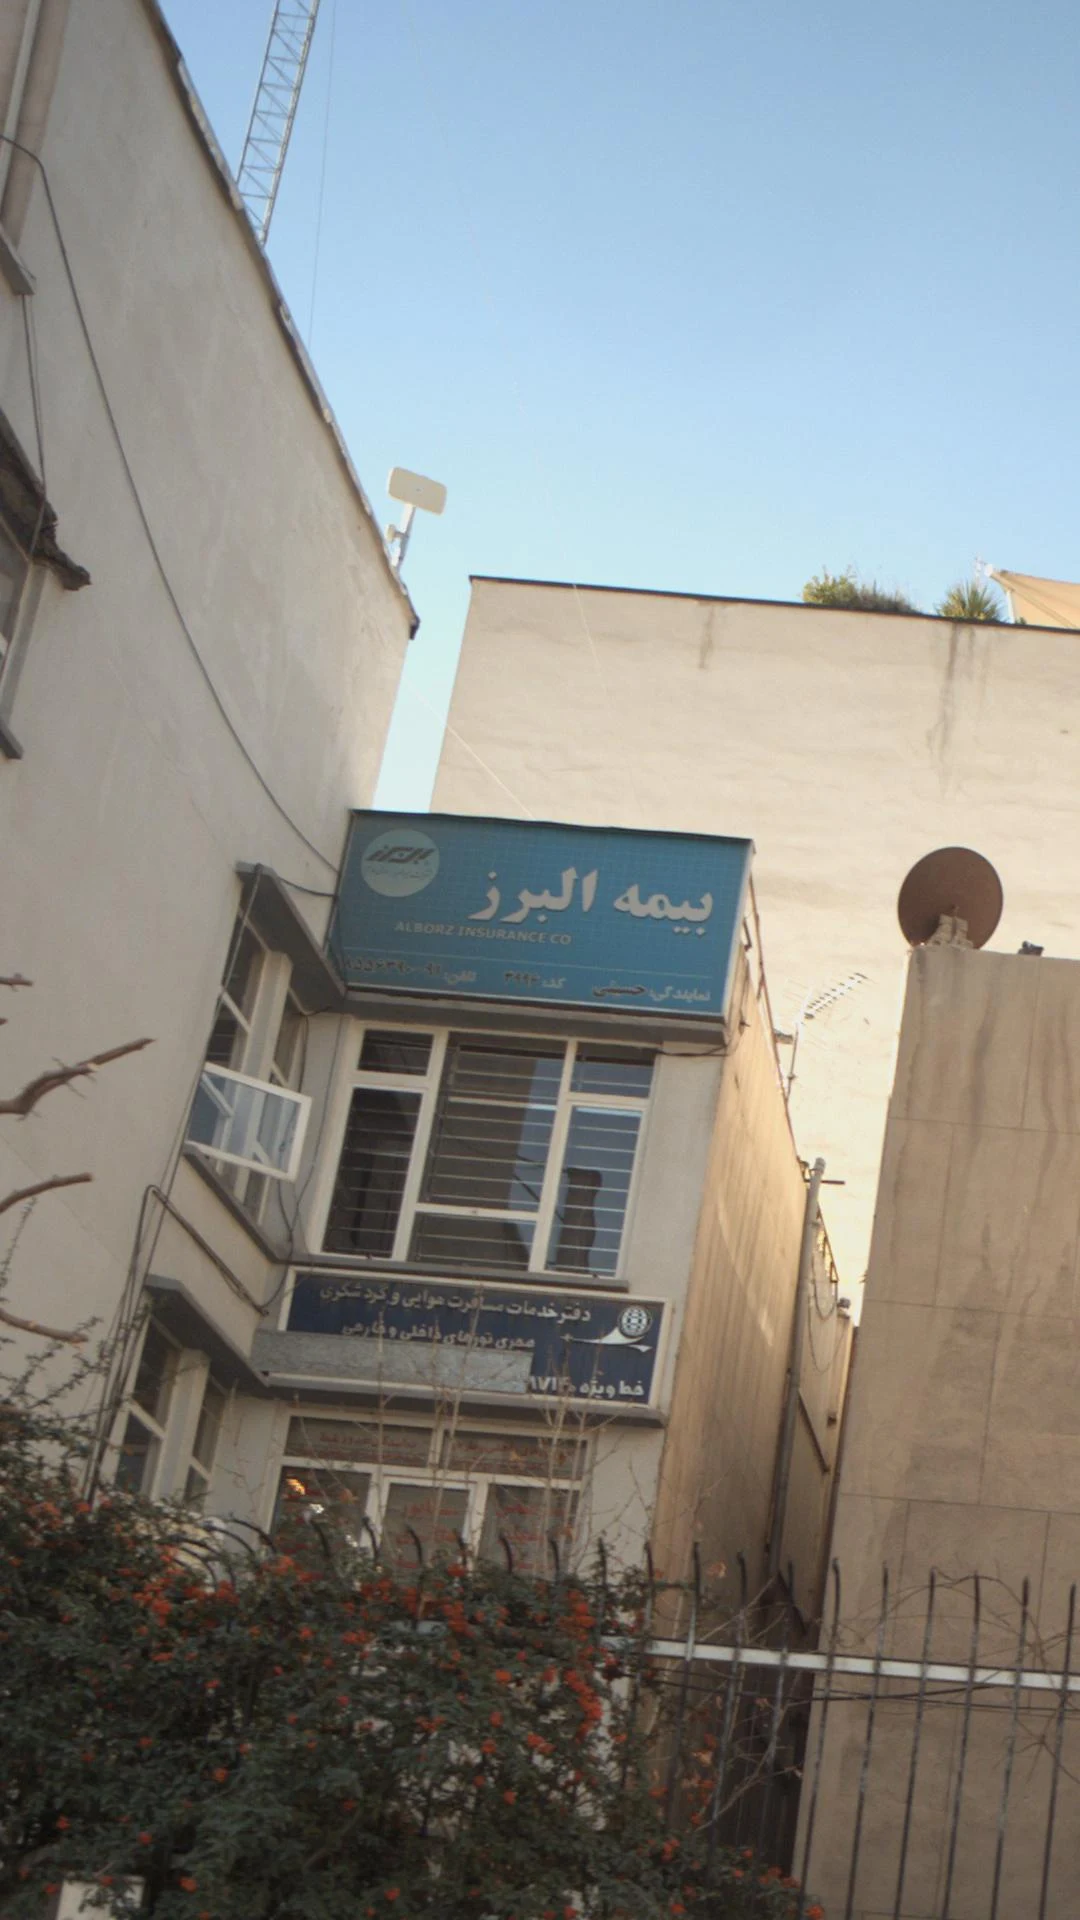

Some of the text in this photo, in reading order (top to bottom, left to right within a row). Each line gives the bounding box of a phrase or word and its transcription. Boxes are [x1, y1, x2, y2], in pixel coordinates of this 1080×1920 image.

[468, 866, 713, 936] بیمه البرز
[394, 921, 572, 945] ALBORZ INSURANCE CO
[386, 1291, 400, 1306] و
[401, 1288, 445, 1310] هوایی
[447, 1295, 504, 1313] مسافرت
[506, 1300, 558, 1318] خدمات
[557, 1301, 592, 1324] دفتر
[400, 1322, 442, 1341] داخلی
[579, 1376, 617, 1399] ویژه
[618, 1380, 645, 1396] خط
